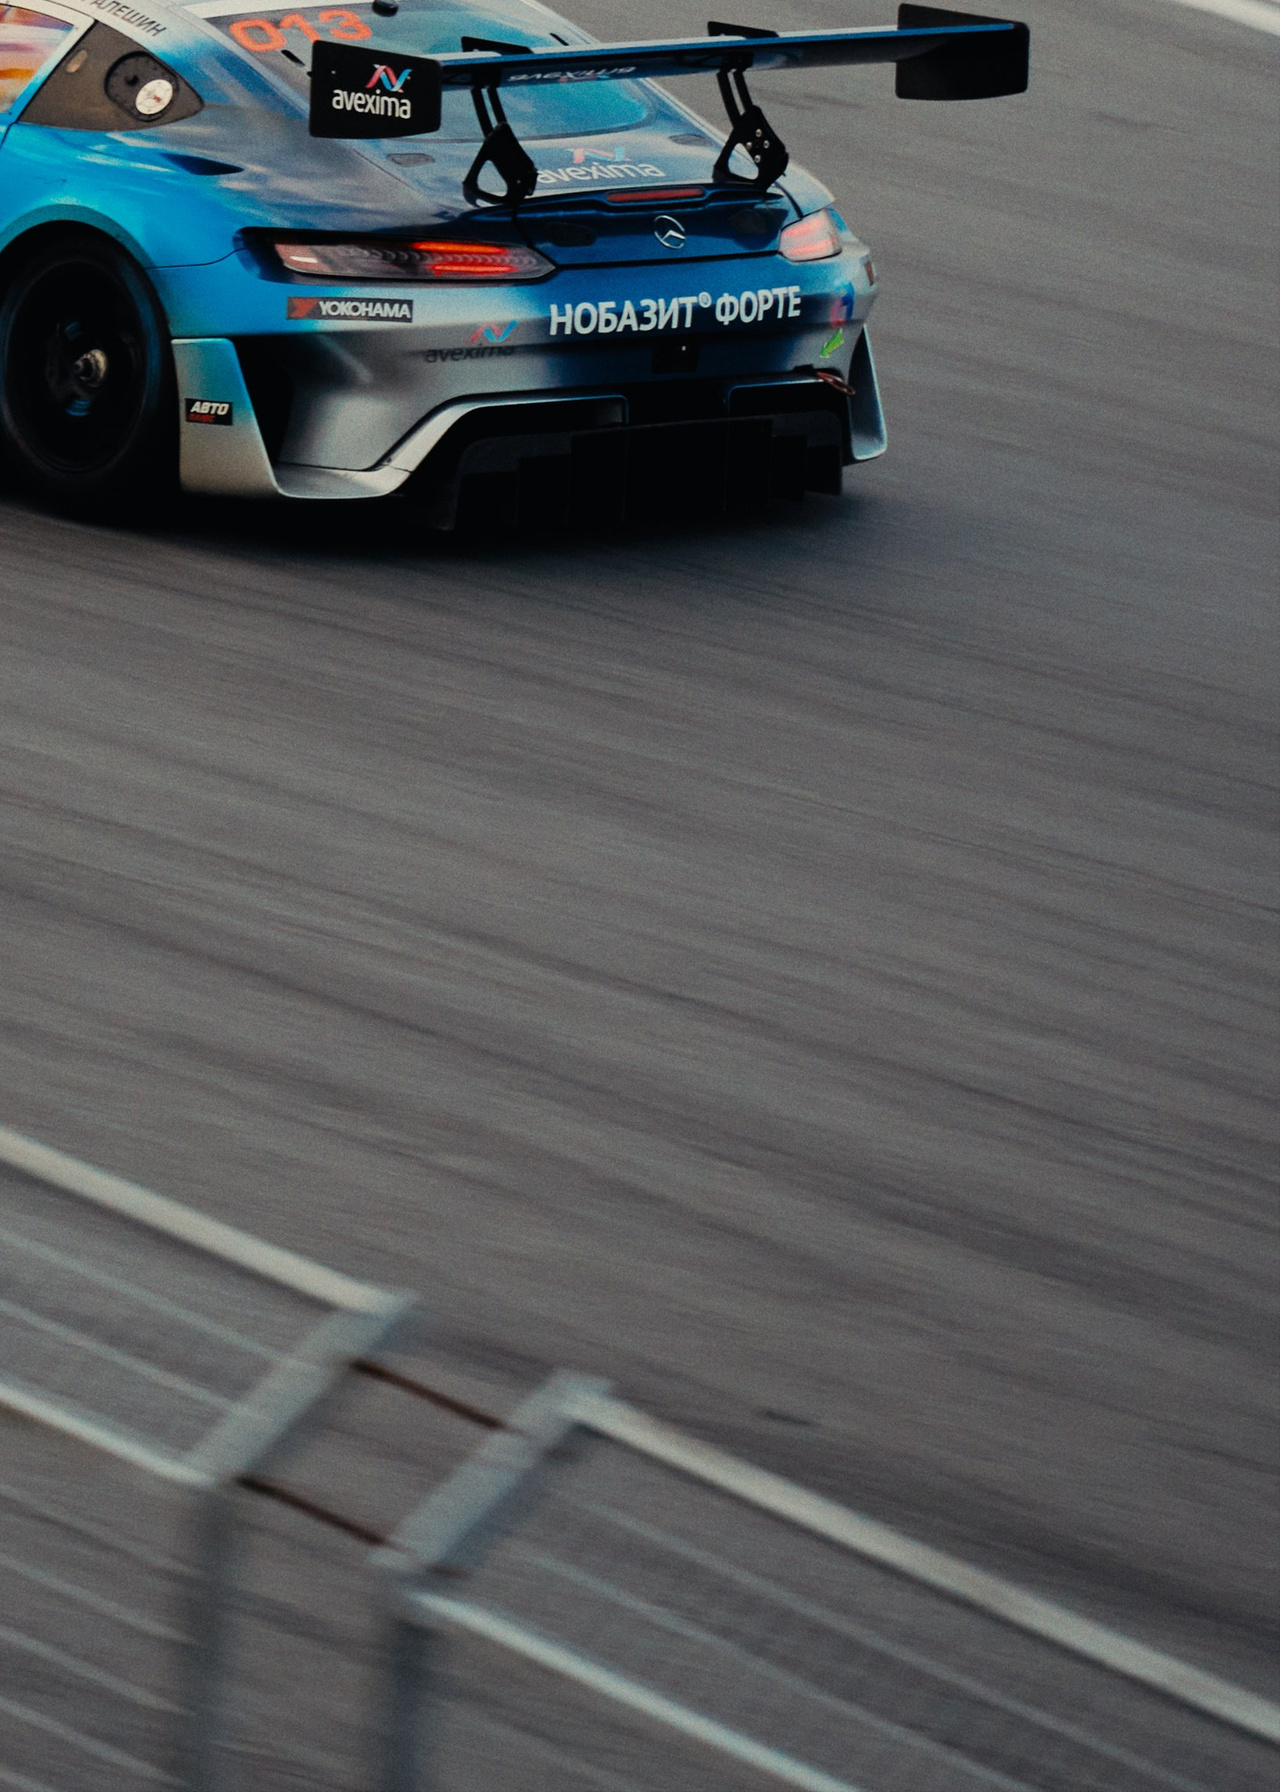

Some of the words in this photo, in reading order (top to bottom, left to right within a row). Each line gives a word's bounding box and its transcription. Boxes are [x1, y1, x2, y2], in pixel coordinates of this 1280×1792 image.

[229, 9, 373, 53] 013
[331, 88, 412, 120] avexima
[536, 161, 667, 184] avexima
[318, 300, 411, 319] YOKOHAMA
[714, 285, 802, 326] ФОРТЕ
[424, 343, 516, 364] avexima
[190, 401, 230, 416] АВТО
